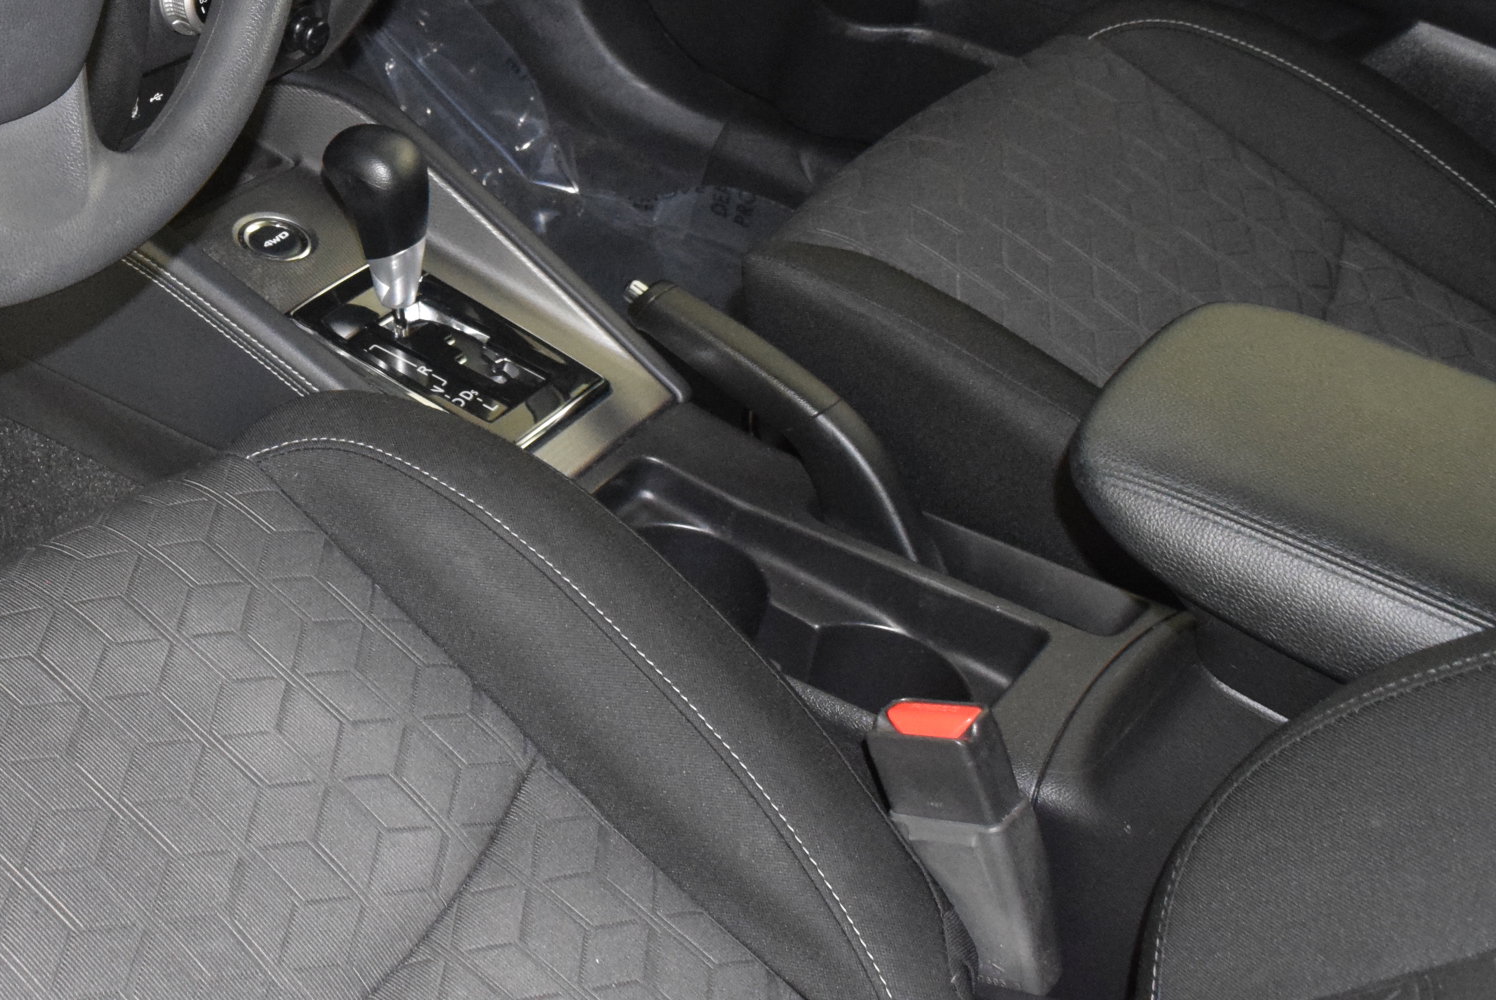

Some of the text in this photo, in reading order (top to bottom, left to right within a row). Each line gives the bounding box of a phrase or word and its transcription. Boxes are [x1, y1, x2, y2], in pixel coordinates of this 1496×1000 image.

[264, 231, 289, 247] 4WD
[416, 365, 433, 376] R
[483, 403, 499, 412] L
